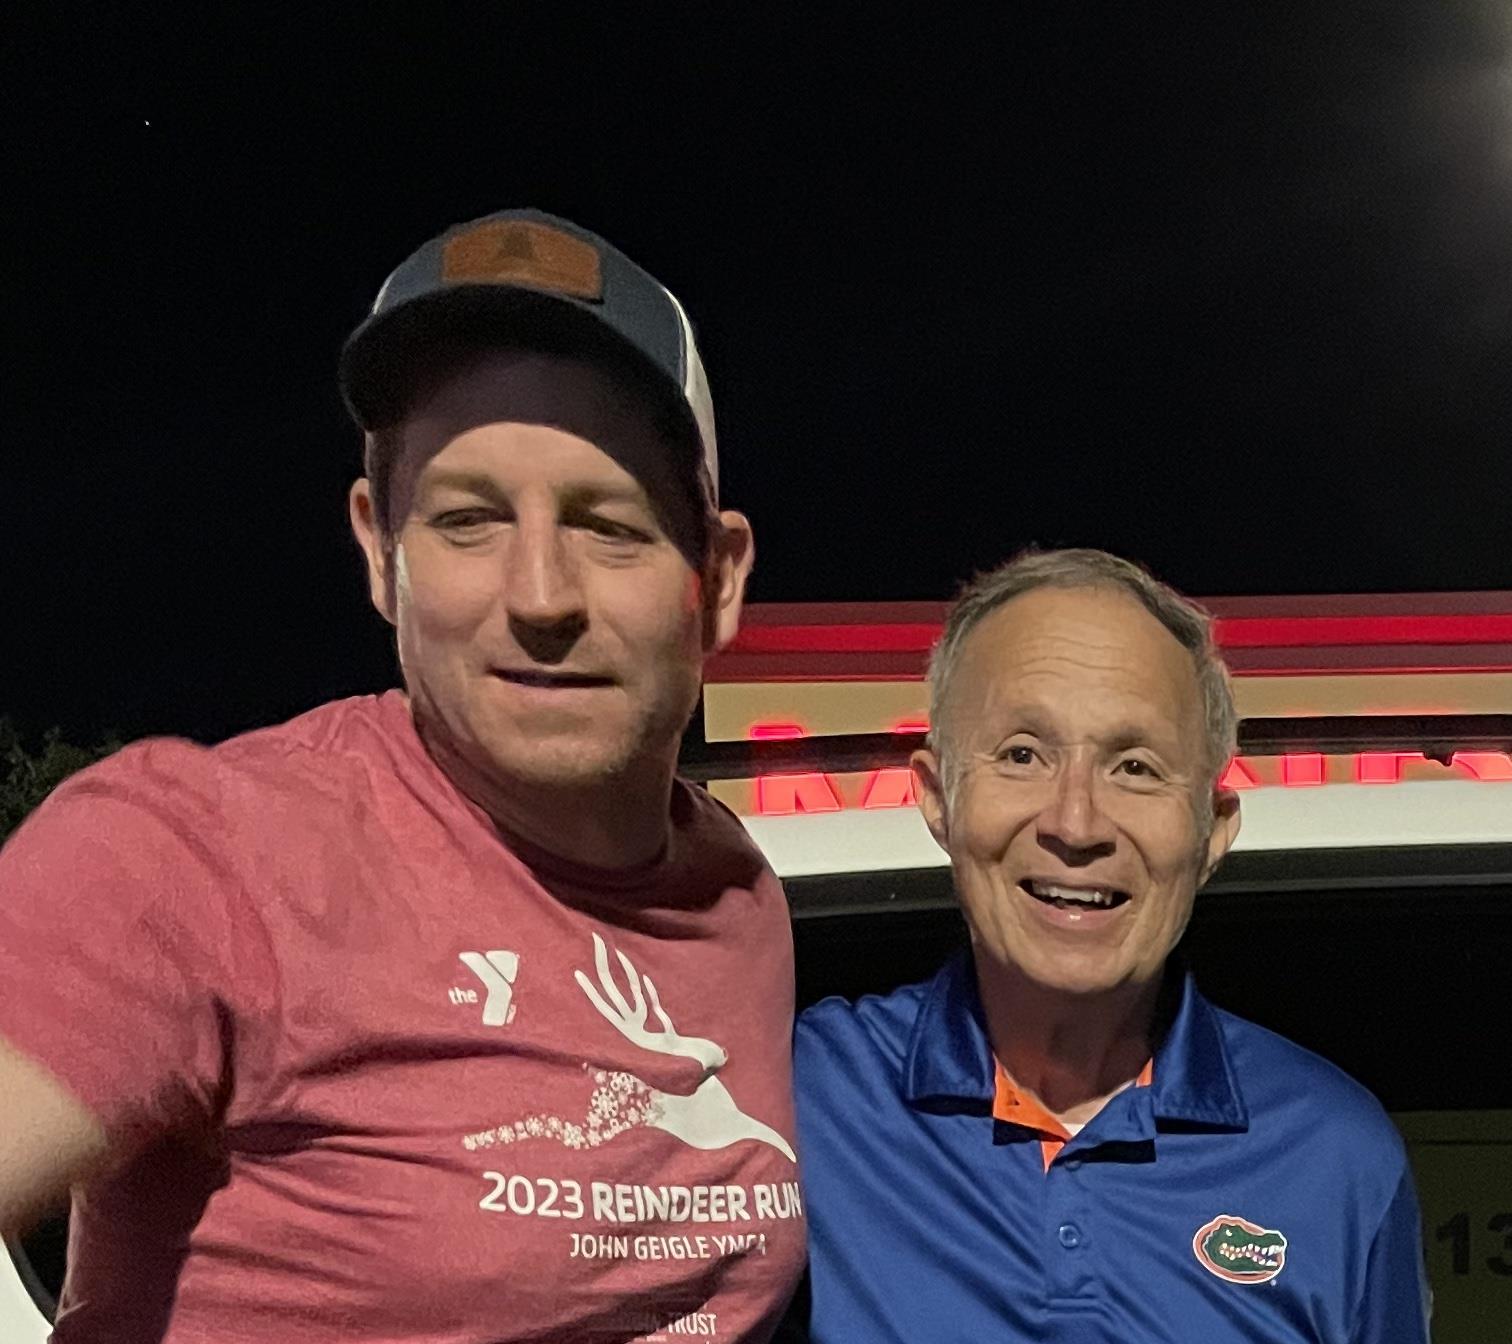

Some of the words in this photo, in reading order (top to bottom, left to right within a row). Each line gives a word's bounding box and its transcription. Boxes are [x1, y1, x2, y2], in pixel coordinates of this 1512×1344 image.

[448, 987, 478, 1005] the
[479, 1171, 584, 1219] 2023
[592, 1182, 751, 1222] REINDEER
[753, 1182, 802, 1220] RUN
[570, 1233, 628, 1258] JOHN
[634, 1234, 711, 1260] GEIGLE
